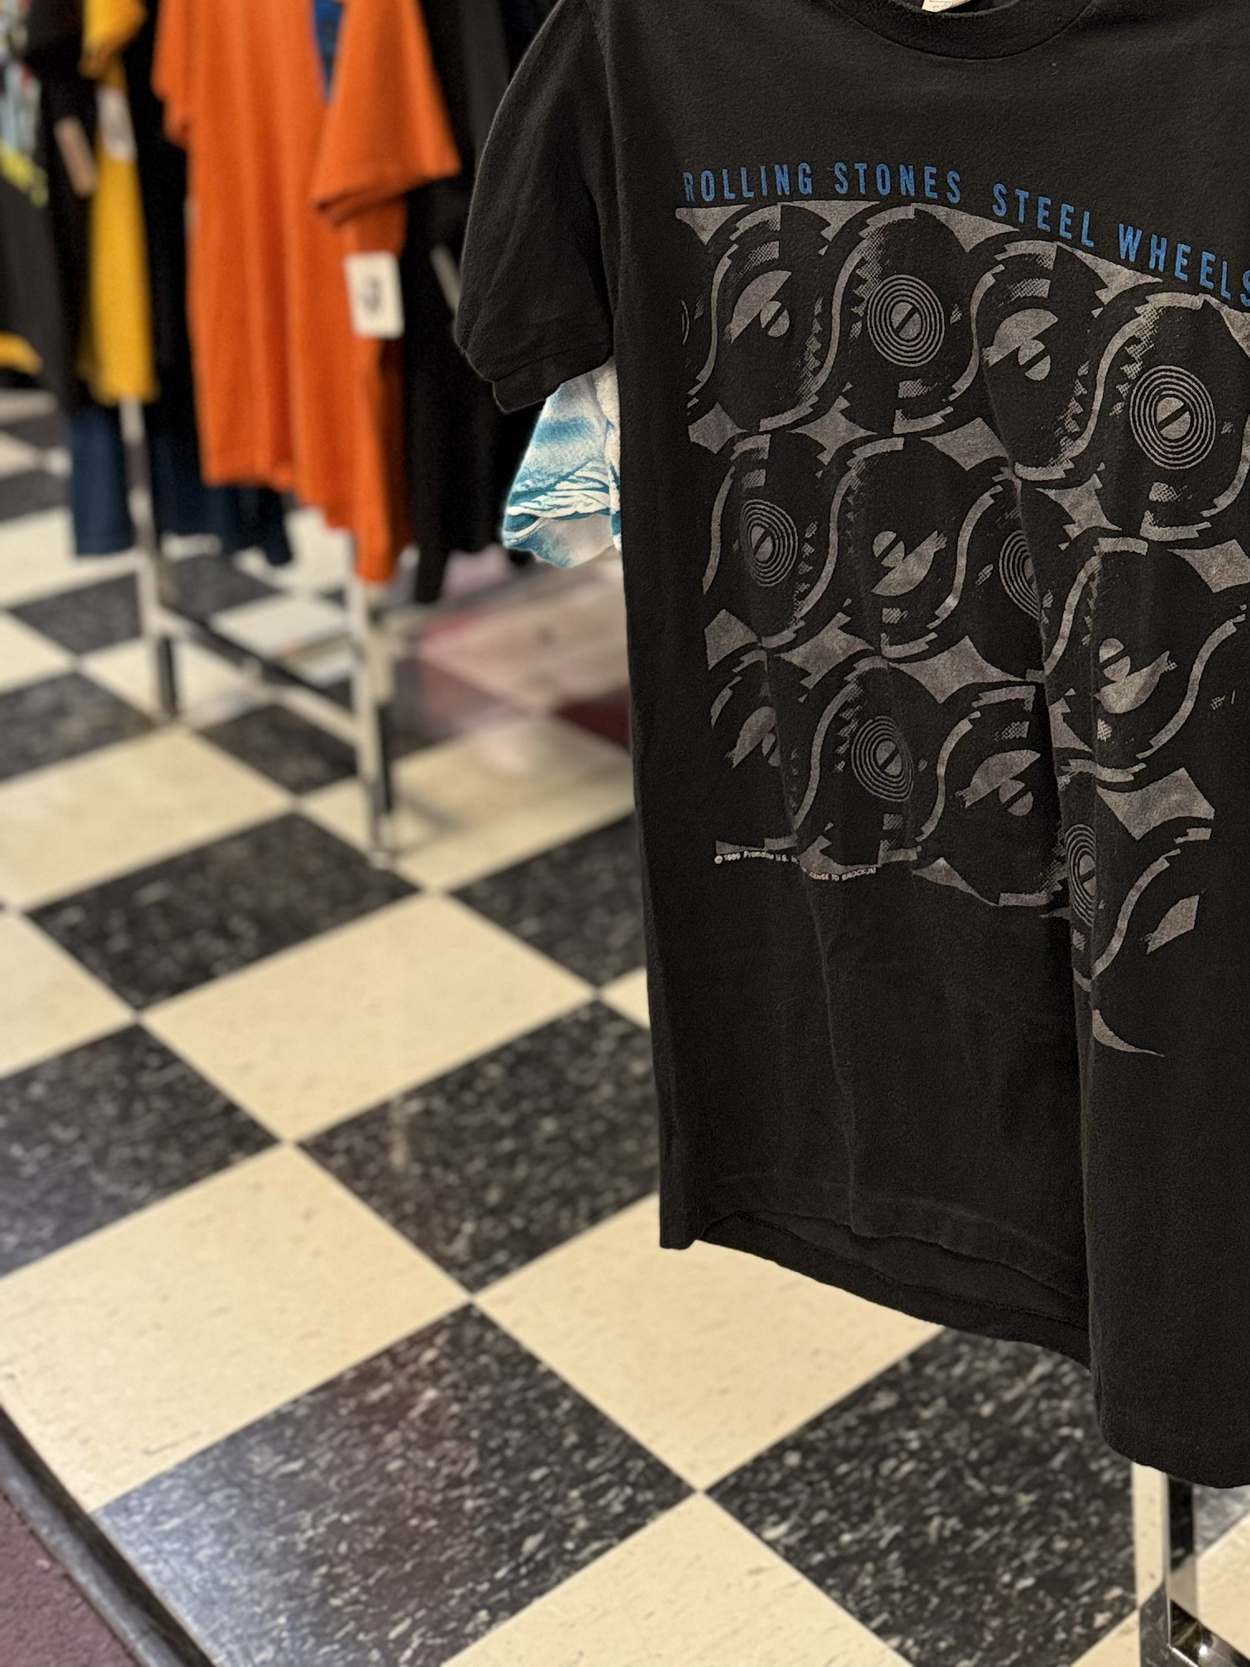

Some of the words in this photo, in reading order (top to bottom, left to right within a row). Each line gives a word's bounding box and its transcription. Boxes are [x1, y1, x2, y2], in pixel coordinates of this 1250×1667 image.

[682, 162, 812, 202] ROLLING
[834, 162, 961, 203] STONES
[992, 182, 1094, 247] STEEL
